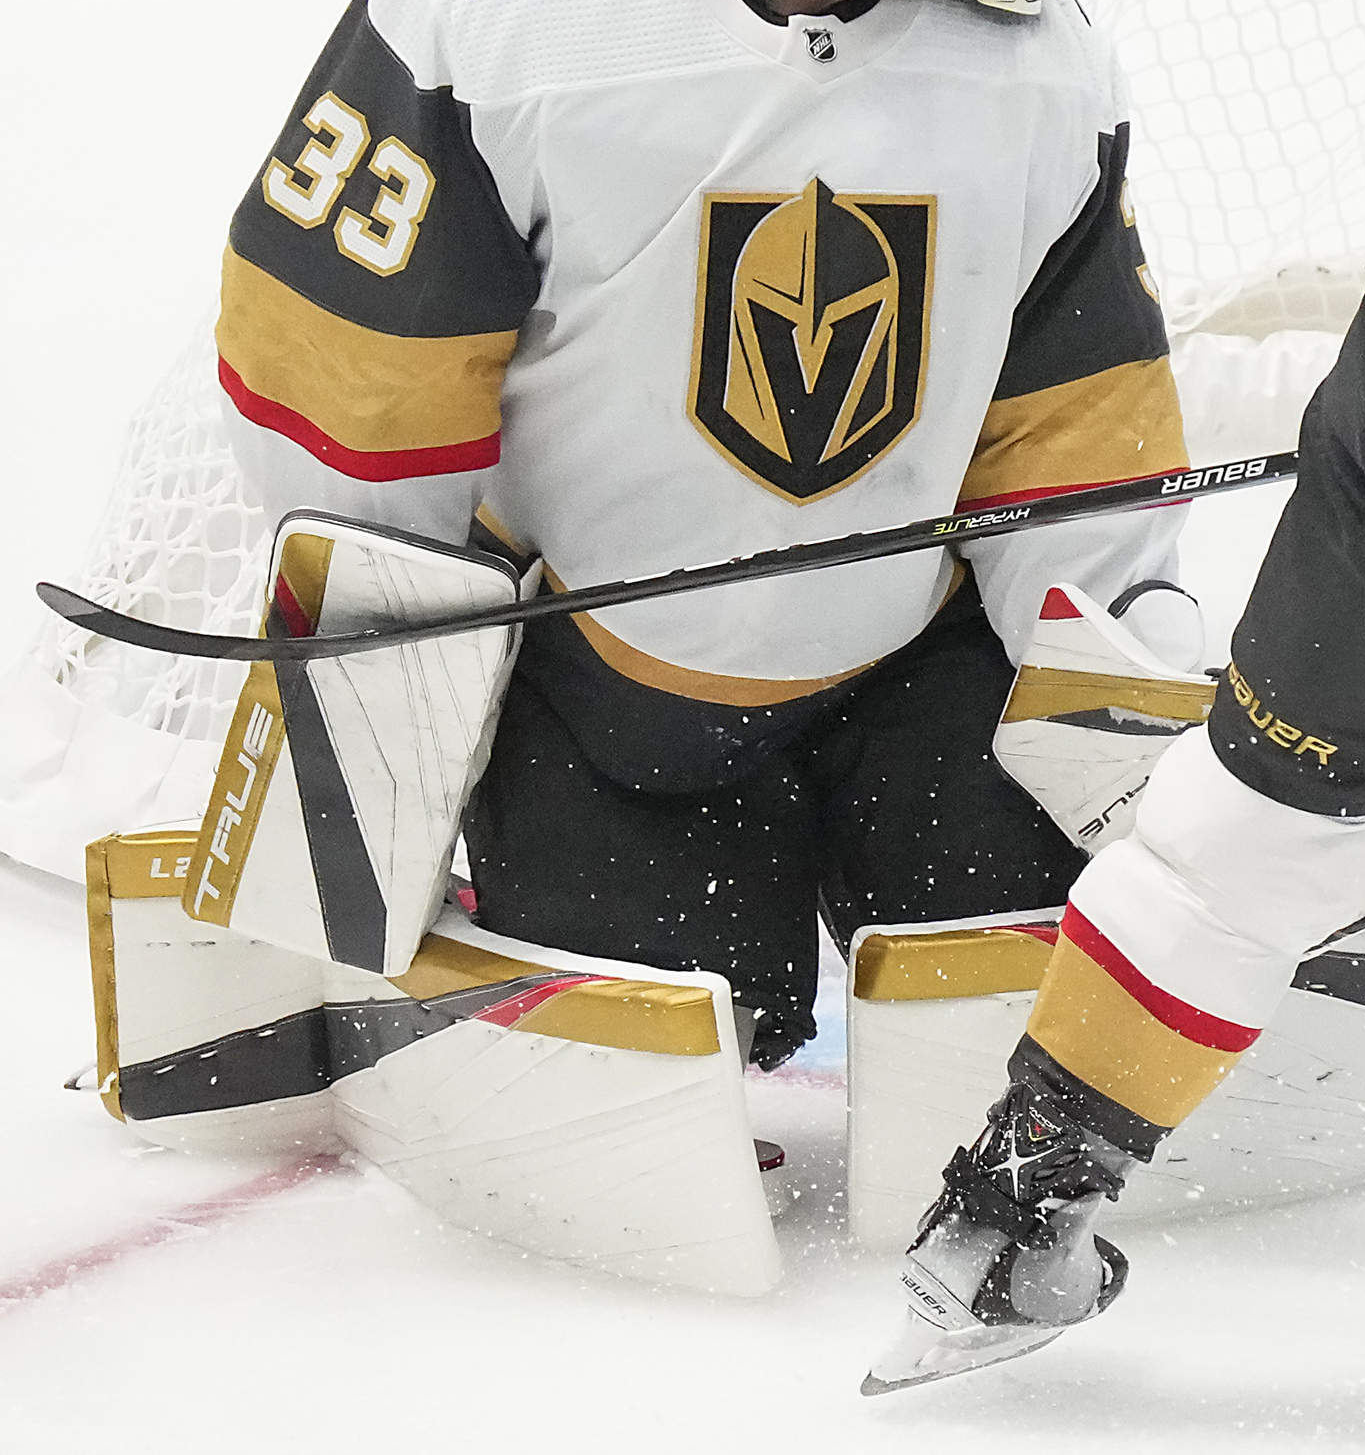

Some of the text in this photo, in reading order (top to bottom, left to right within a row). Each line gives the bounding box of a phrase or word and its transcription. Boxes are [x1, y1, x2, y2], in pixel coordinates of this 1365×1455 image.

[261, 90, 437, 278] 33
[933, 506, 1032, 536] HYPERLITE
[1160, 458, 1268, 495] BAUER
[193, 701, 274, 916] TRUE
